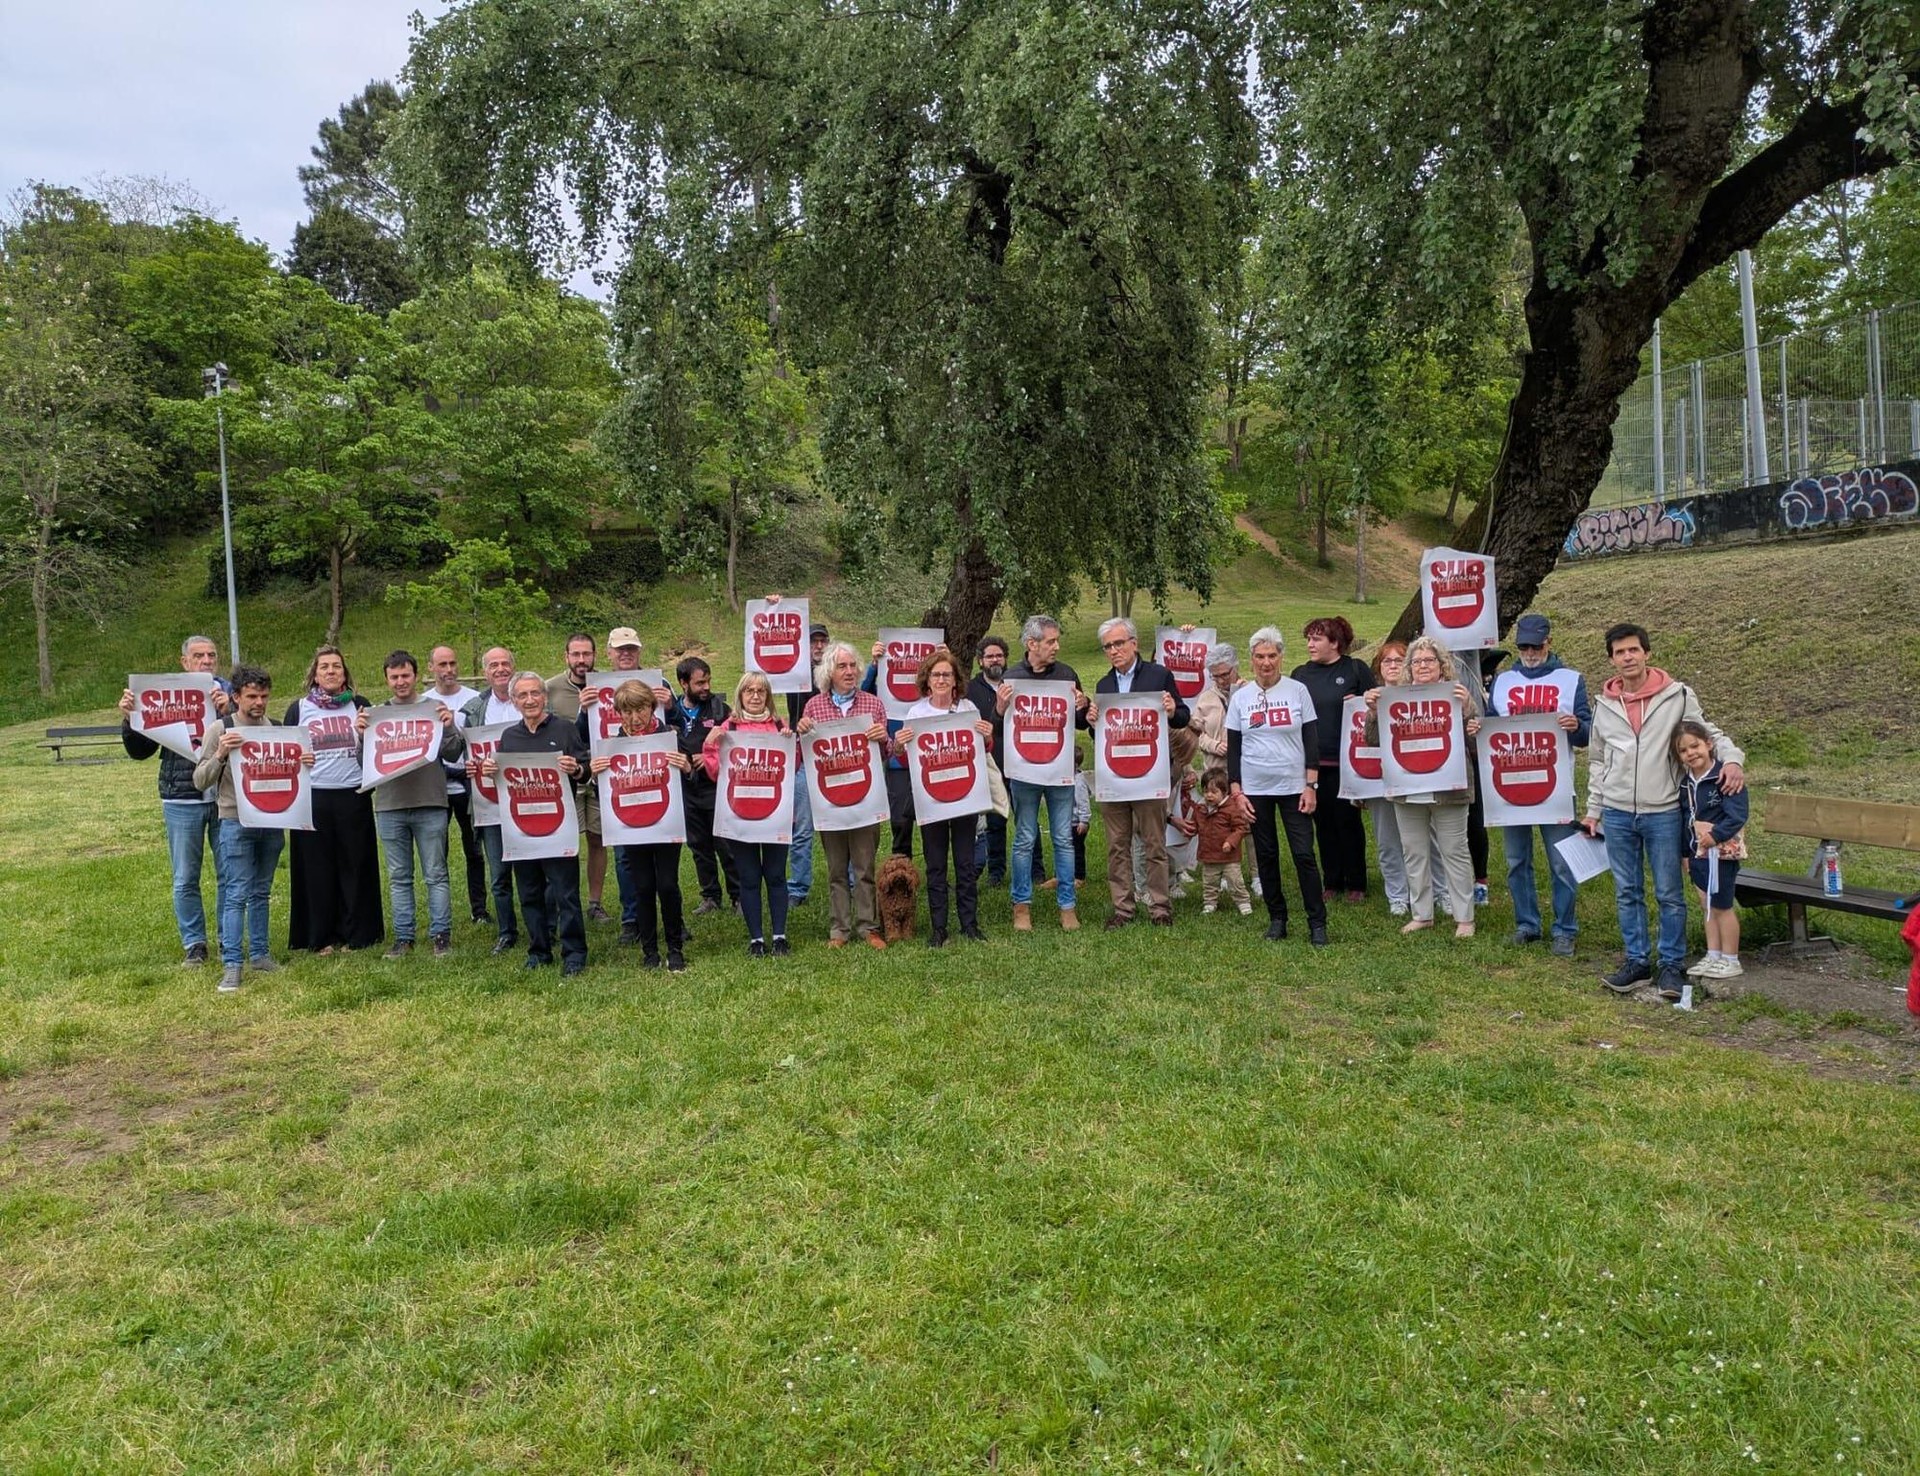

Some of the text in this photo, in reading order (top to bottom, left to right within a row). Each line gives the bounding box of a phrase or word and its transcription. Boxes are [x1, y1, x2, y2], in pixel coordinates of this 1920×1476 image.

[1431, 560, 1485, 586] SUB
[753, 613, 801, 635] SUB
[1164, 640, 1207, 664] SUB
[141, 690, 205, 715] SUB
[1014, 695, 1067, 721] SUB
[1507, 685, 1559, 710] SUB
[308, 716, 352, 739] SUB
[1105, 708, 1159, 735] SUB
[1273, 712, 1287, 721] EZ
[1389, 700, 1452, 730] SUB
[375, 720, 433, 744] SUB
[918, 730, 976, 758] SUB
[240, 741, 302, 769] SUB
[813, 734, 870, 761] SUB
[1489, 731, 1557, 762] SUB
[610, 752, 669, 780] SUB
[729, 747, 786, 775] SUB
[504, 767, 562, 793] SUB
